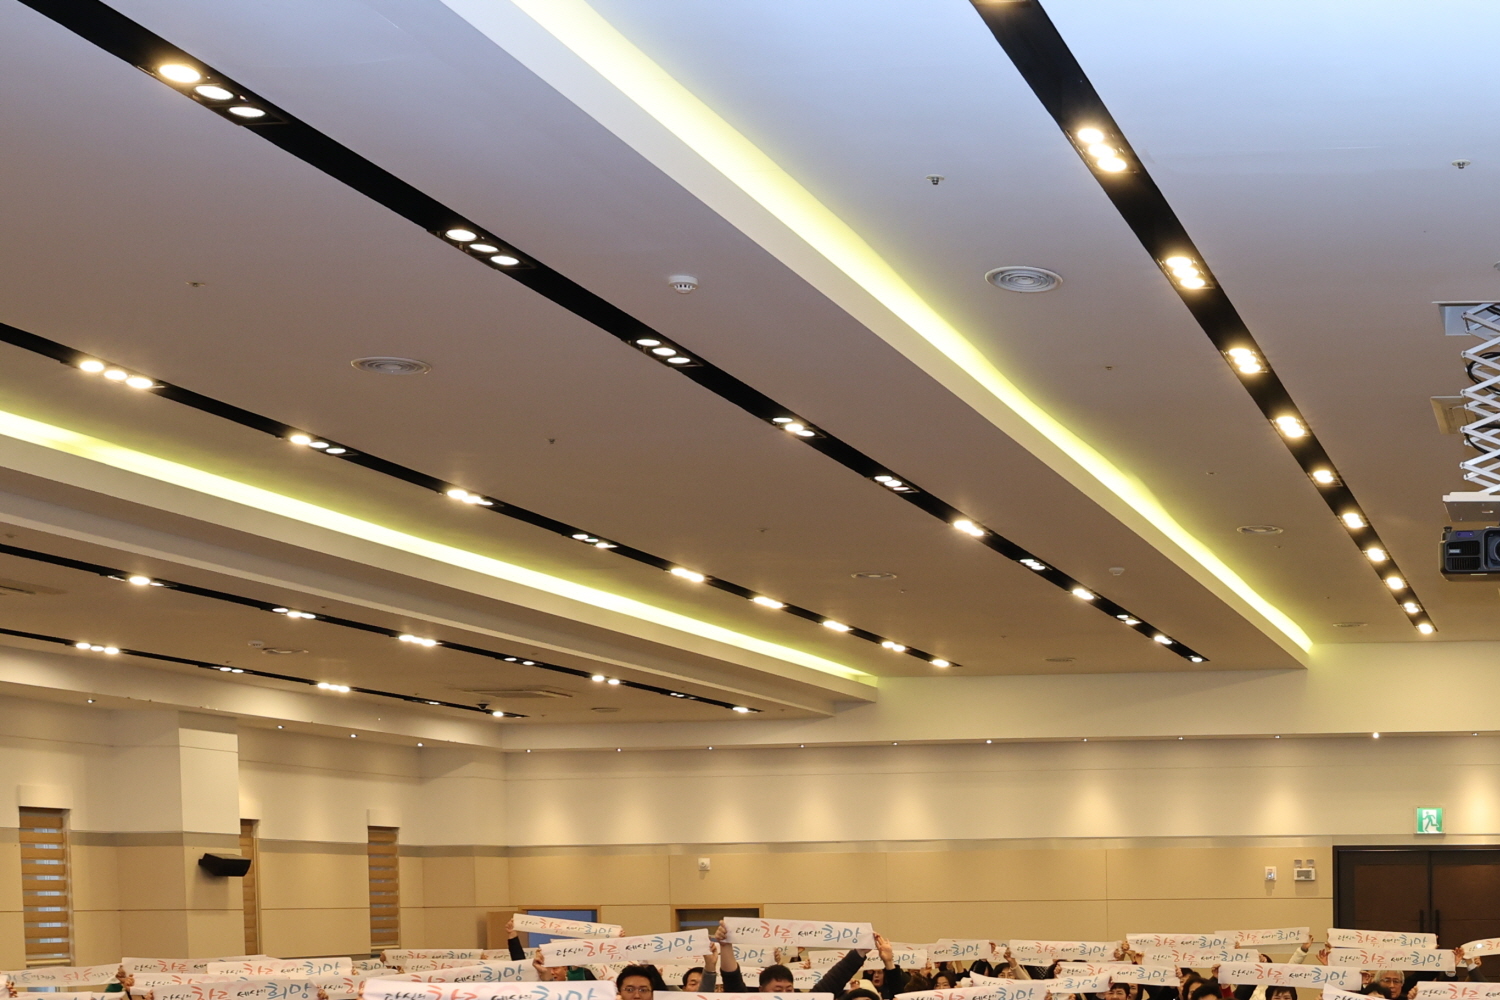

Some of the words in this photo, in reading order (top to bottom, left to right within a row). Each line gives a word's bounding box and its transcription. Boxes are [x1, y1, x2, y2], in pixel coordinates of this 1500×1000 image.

[584, 924, 613, 938] 희망
[735, 927, 761, 936] 당신의
[822, 924, 862, 943] 희망
[556, 948, 583, 957] 당신의
[625, 943, 653, 951] 세상의
[651, 935, 696, 953] 희망
[1199, 936, 1228, 949] 희망
[1400, 933, 1427, 949] 희망
[951, 944, 980, 957] 희망
[1079, 943, 1107, 957] 희망
[1411, 951, 1443, 967] 희망
[303, 961, 341, 975] 희망
[480, 964, 525, 982] 희망
[1136, 967, 1168, 982] 희망
[1311, 967, 1348, 985] 희망
[237, 989, 266, 998] 세상의
[265, 982, 312, 999] 희망
[1422, 989, 1447, 998] 당신의
